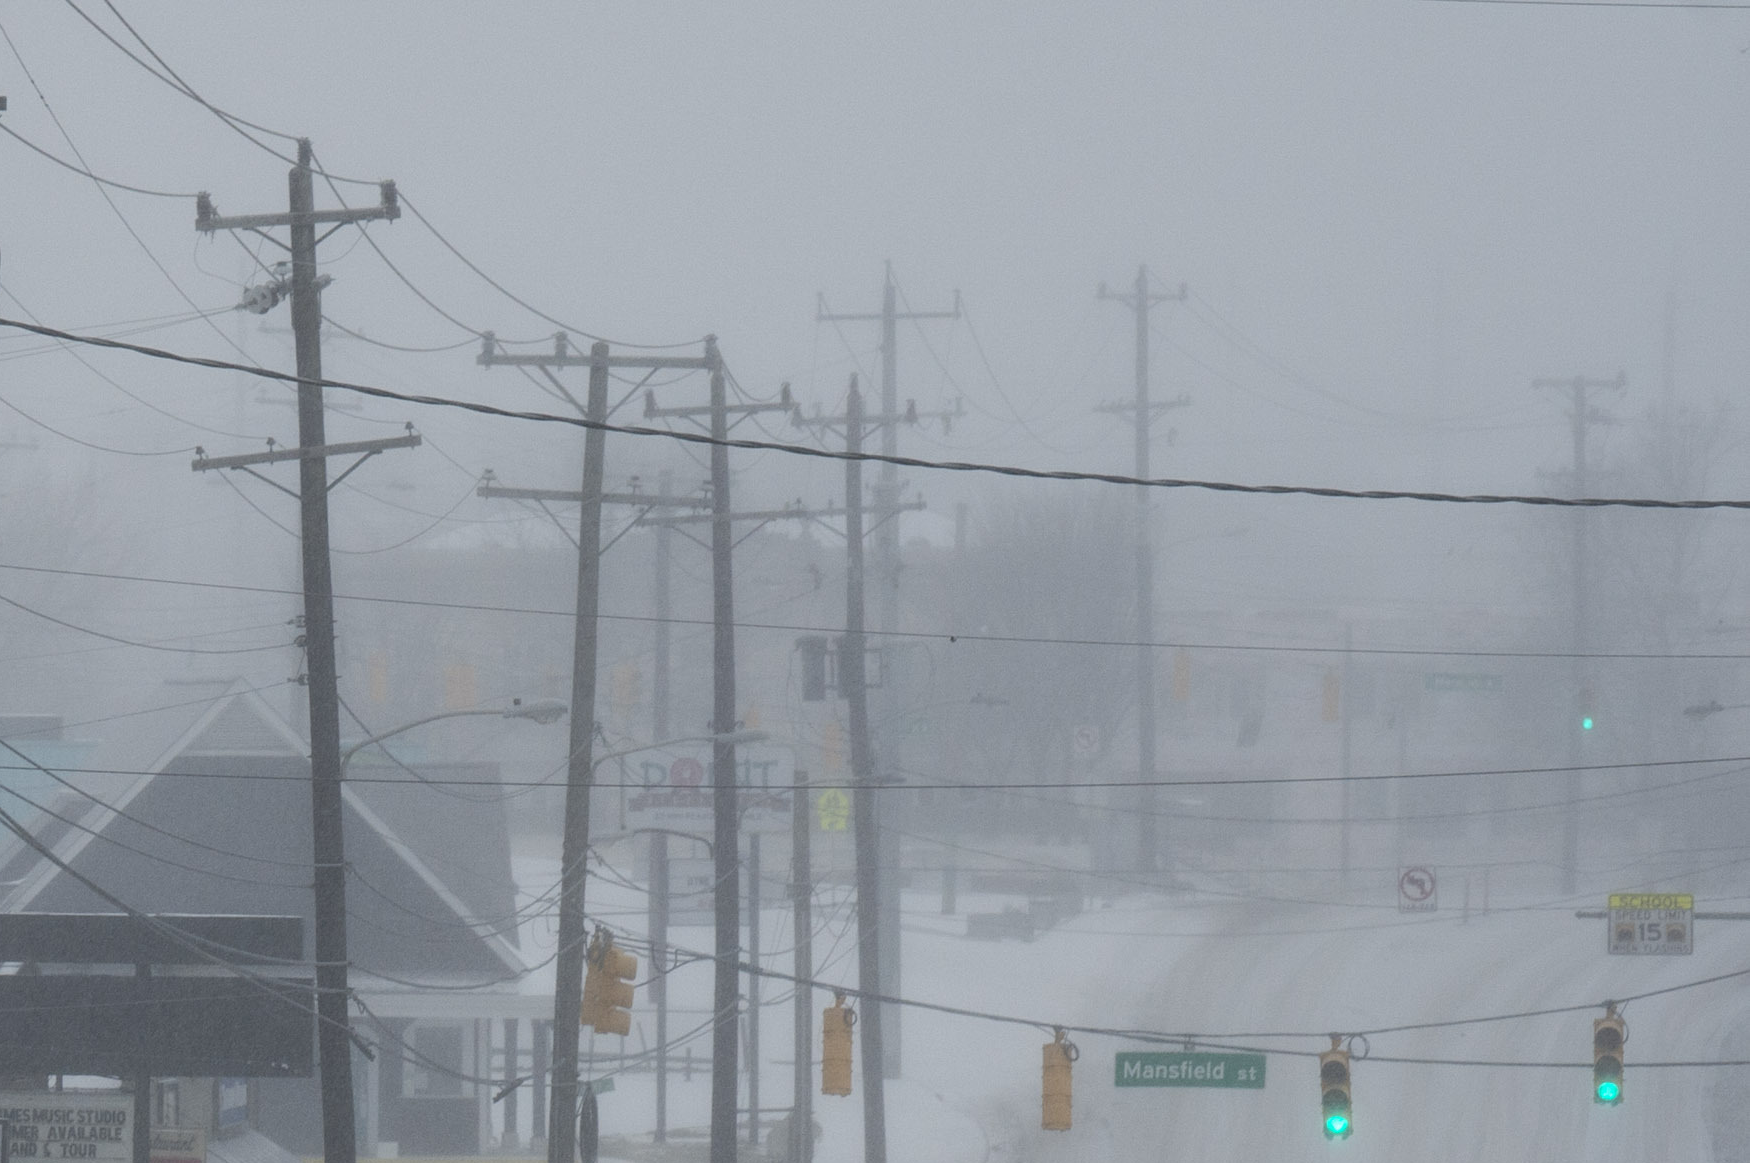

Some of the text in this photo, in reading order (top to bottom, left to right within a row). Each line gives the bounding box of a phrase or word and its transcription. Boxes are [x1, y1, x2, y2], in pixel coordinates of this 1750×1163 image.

[1618, 895, 1681, 909] SCHOOL
[1615, 910, 1686, 920] SPEED LIMIT
[1639, 922, 1662, 942] 15
[1123, 1060, 1257, 1080] Mansfield st
[33, 1108, 75, 1124] MUSIC
[78, 1109, 126, 1125] STUDIO
[47, 1126, 122, 1141] AVAILABLE
[61, 1143, 97, 1158] TOUR
